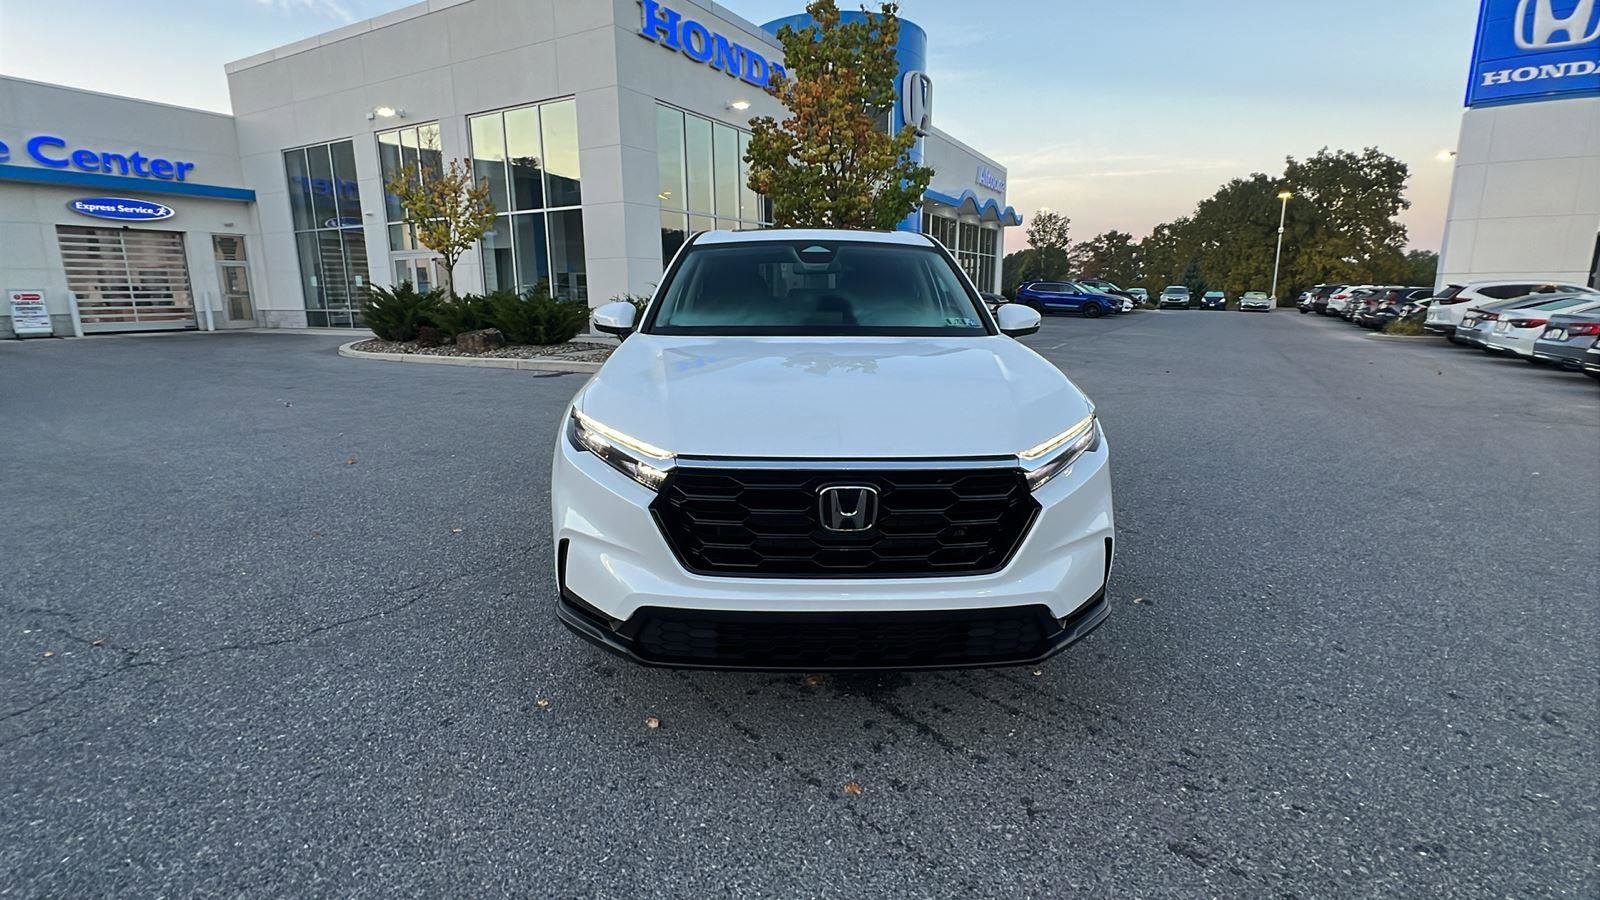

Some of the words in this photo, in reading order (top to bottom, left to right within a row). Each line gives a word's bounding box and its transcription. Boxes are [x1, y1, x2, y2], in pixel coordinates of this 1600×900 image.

[27, 136, 194, 181] Center
[75, 201, 116, 212] Express
[117, 205, 154, 214] Service
